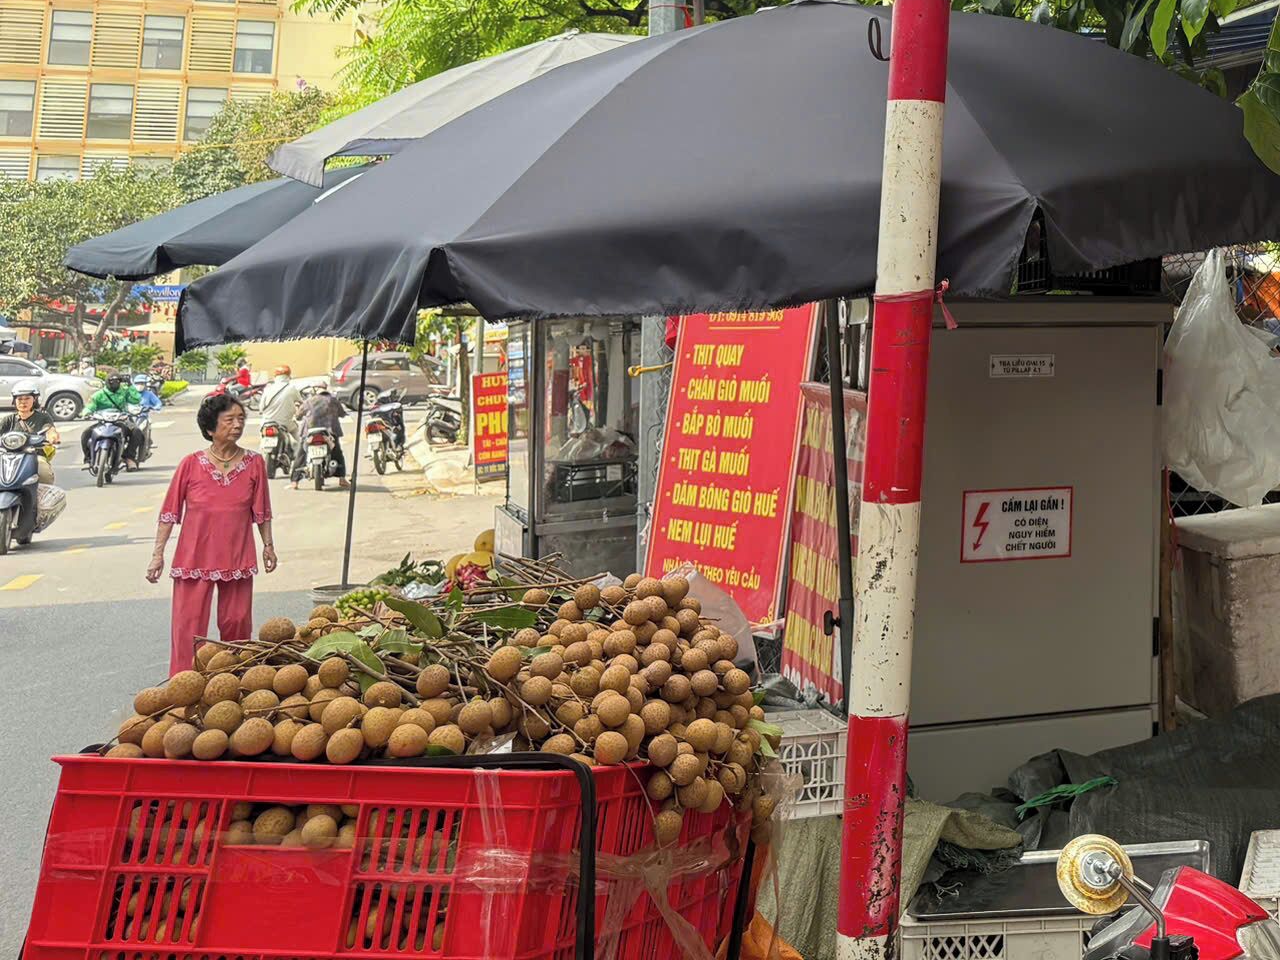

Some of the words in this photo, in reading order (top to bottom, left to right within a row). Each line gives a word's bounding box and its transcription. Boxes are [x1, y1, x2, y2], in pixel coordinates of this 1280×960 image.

[693, 344, 715, 369] THỊT
[716, 344, 745, 367] QUAY
[687, 375, 717, 401] CHÂN
[738, 373, 771, 403] MUỐI
[682, 405, 704, 435] BẮP
[722, 409, 754, 439] MUỐI
[678, 447, 700, 475] THỊT
[702, 445, 716, 472] GÀ
[719, 445, 750, 476] MUỐI
[698, 483, 729, 512] BÔNG
[753, 488, 780, 517] HUẾ
[1001, 496, 1022, 513] CẤM
[1024, 499, 1038, 514] LẠI
[667, 518, 693, 542] NEM
[694, 523, 712, 550] LỤI
[713, 520, 739, 550] HUẾ
[1008, 530, 1033, 539] NGUY
[1014, 516, 1026, 527] CÓ
[1028, 516, 1048, 528] ĐIỆN
[1005, 540, 1026, 552] CHẾT
[1028, 539, 1056, 550] NGƯỜI
[703, 565, 723, 582] THEO
[725, 566, 741, 586] YÊU
